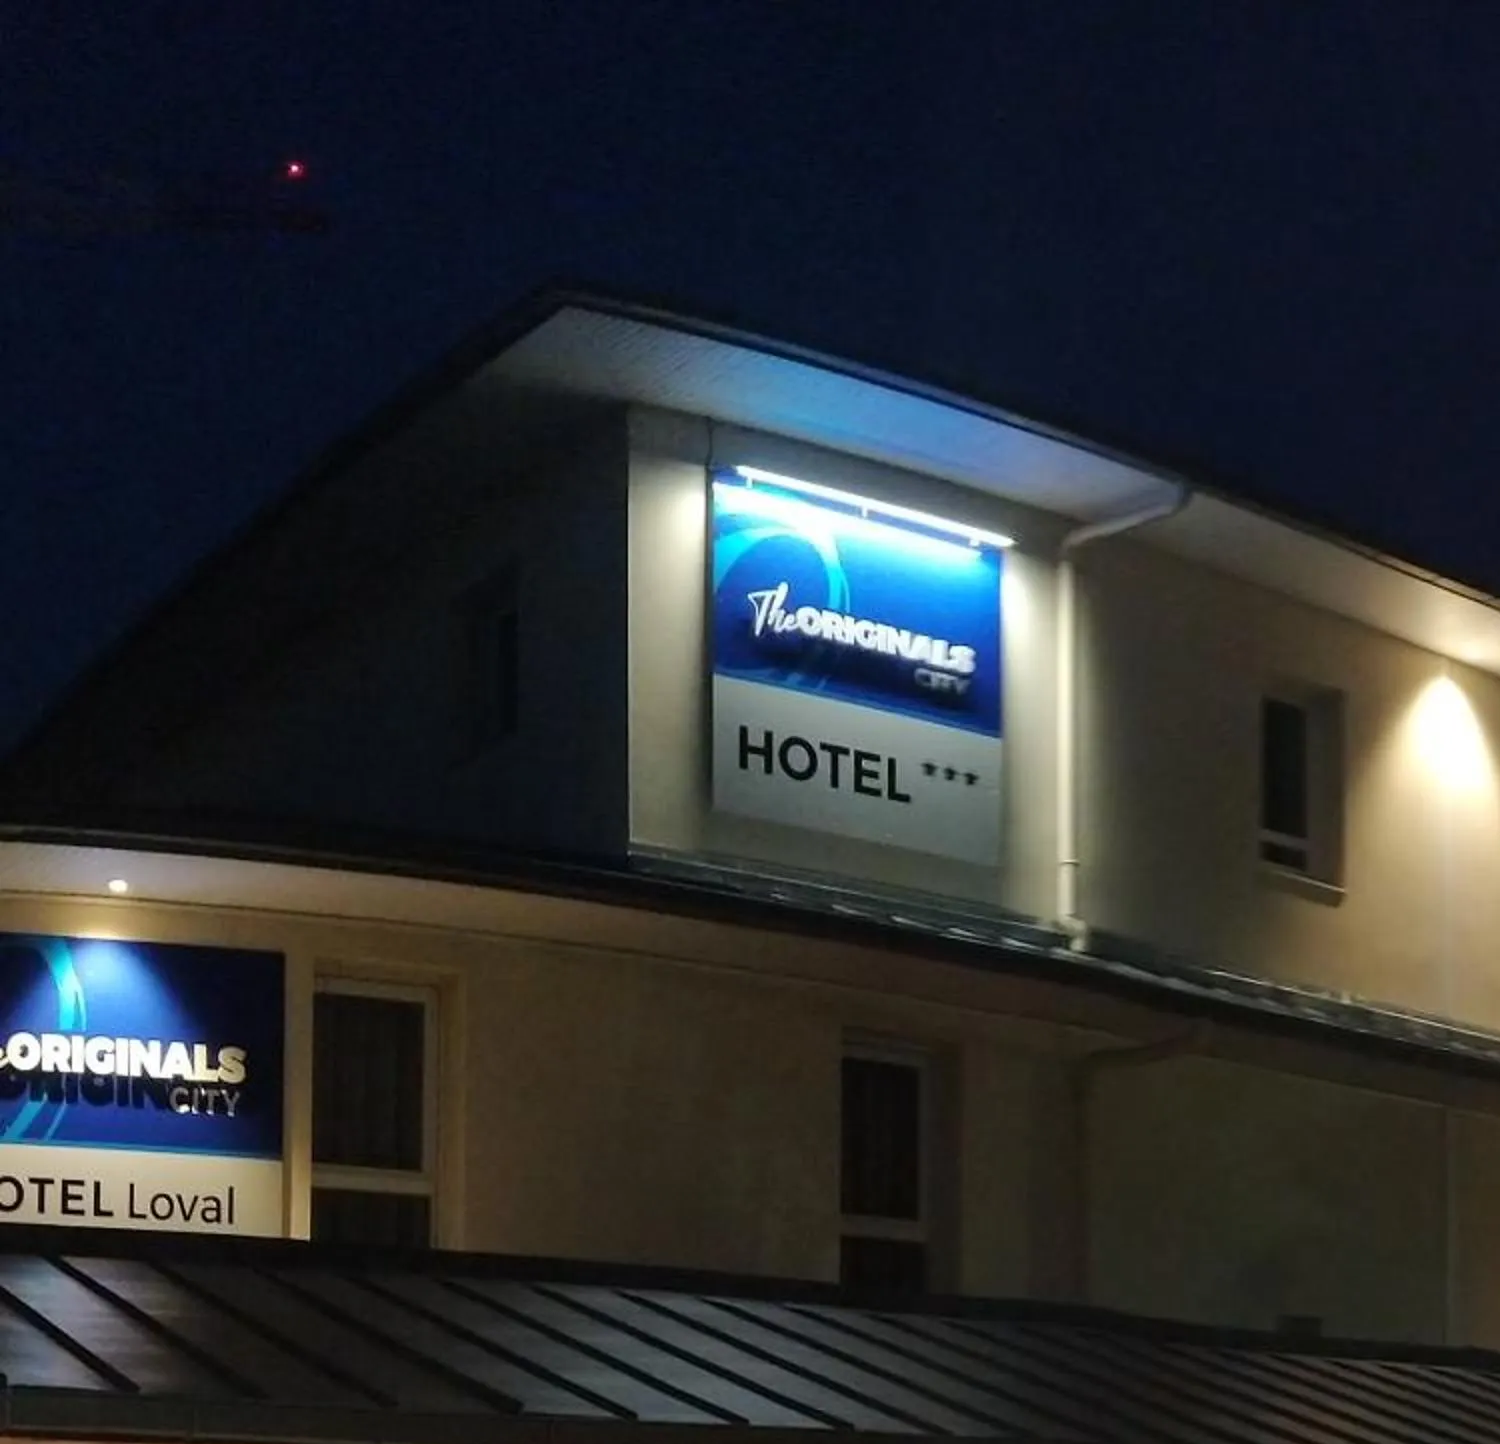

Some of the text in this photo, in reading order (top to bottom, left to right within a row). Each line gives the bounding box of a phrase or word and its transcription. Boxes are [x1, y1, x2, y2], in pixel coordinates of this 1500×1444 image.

[914, 668, 971, 695] CITY
[738, 726, 912, 803] HOTEL
[6, 1031, 248, 1085] ORIGINALS
[169, 1085, 241, 1118] CITY
[128, 1182, 235, 1225] Loval
